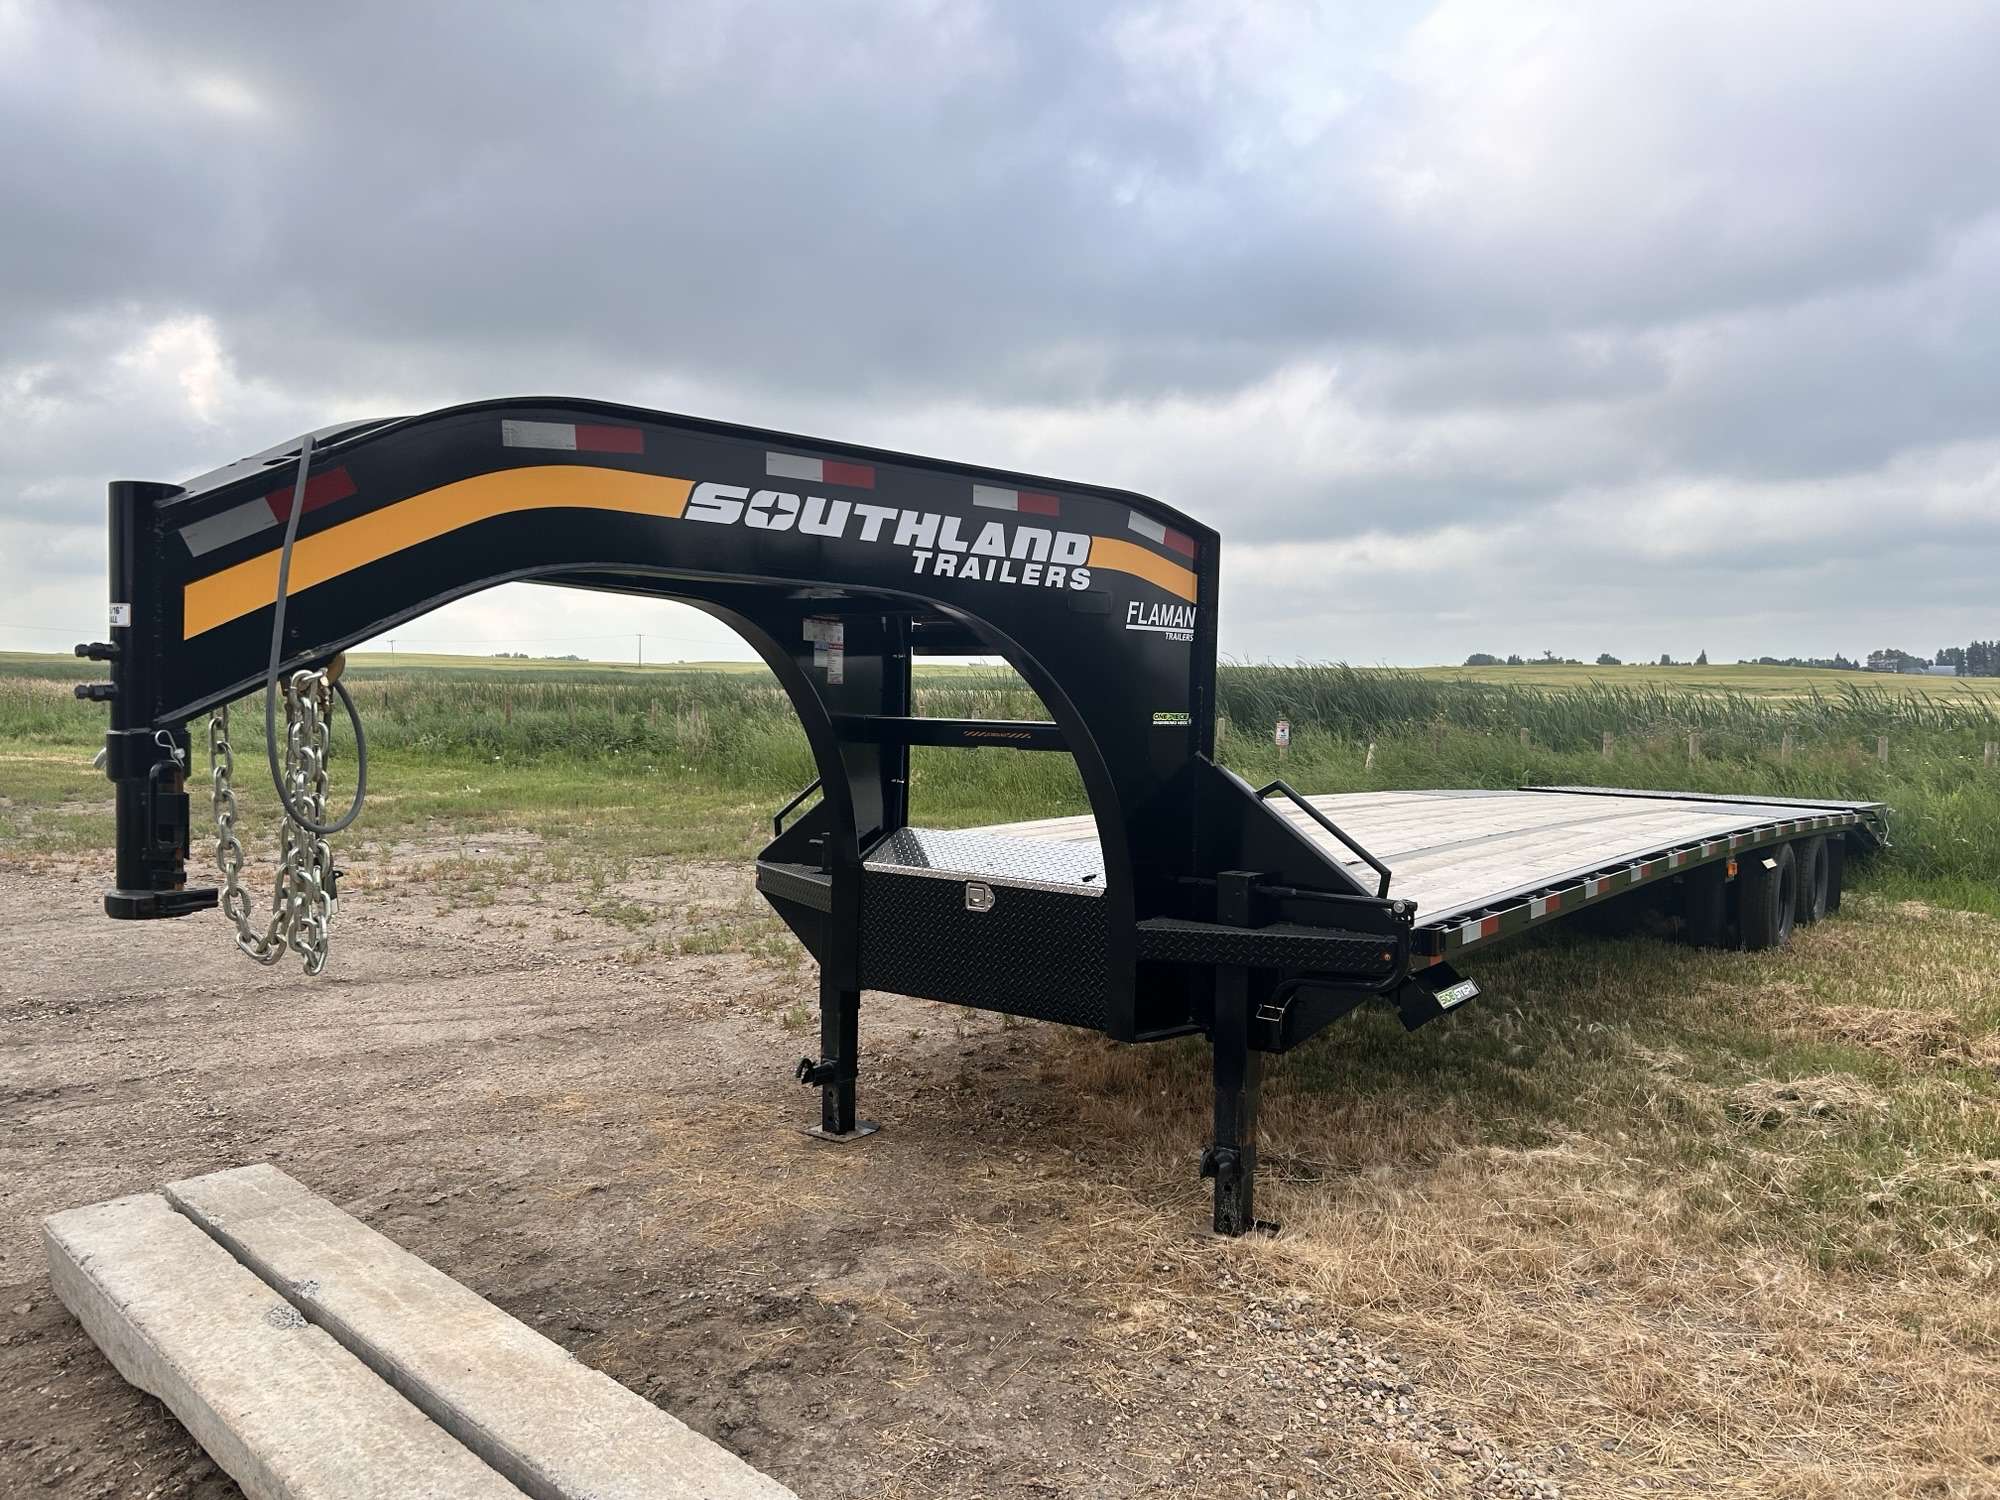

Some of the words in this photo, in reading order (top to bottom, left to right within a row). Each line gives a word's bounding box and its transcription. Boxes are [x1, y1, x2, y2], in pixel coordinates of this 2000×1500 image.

[685, 481, 1091, 567] SOUTHLAND
[912, 550, 1091, 590] TRAILERS
[1126, 601, 1197, 628] FLAMAN
[1165, 632, 1194, 641] TRAILERS
